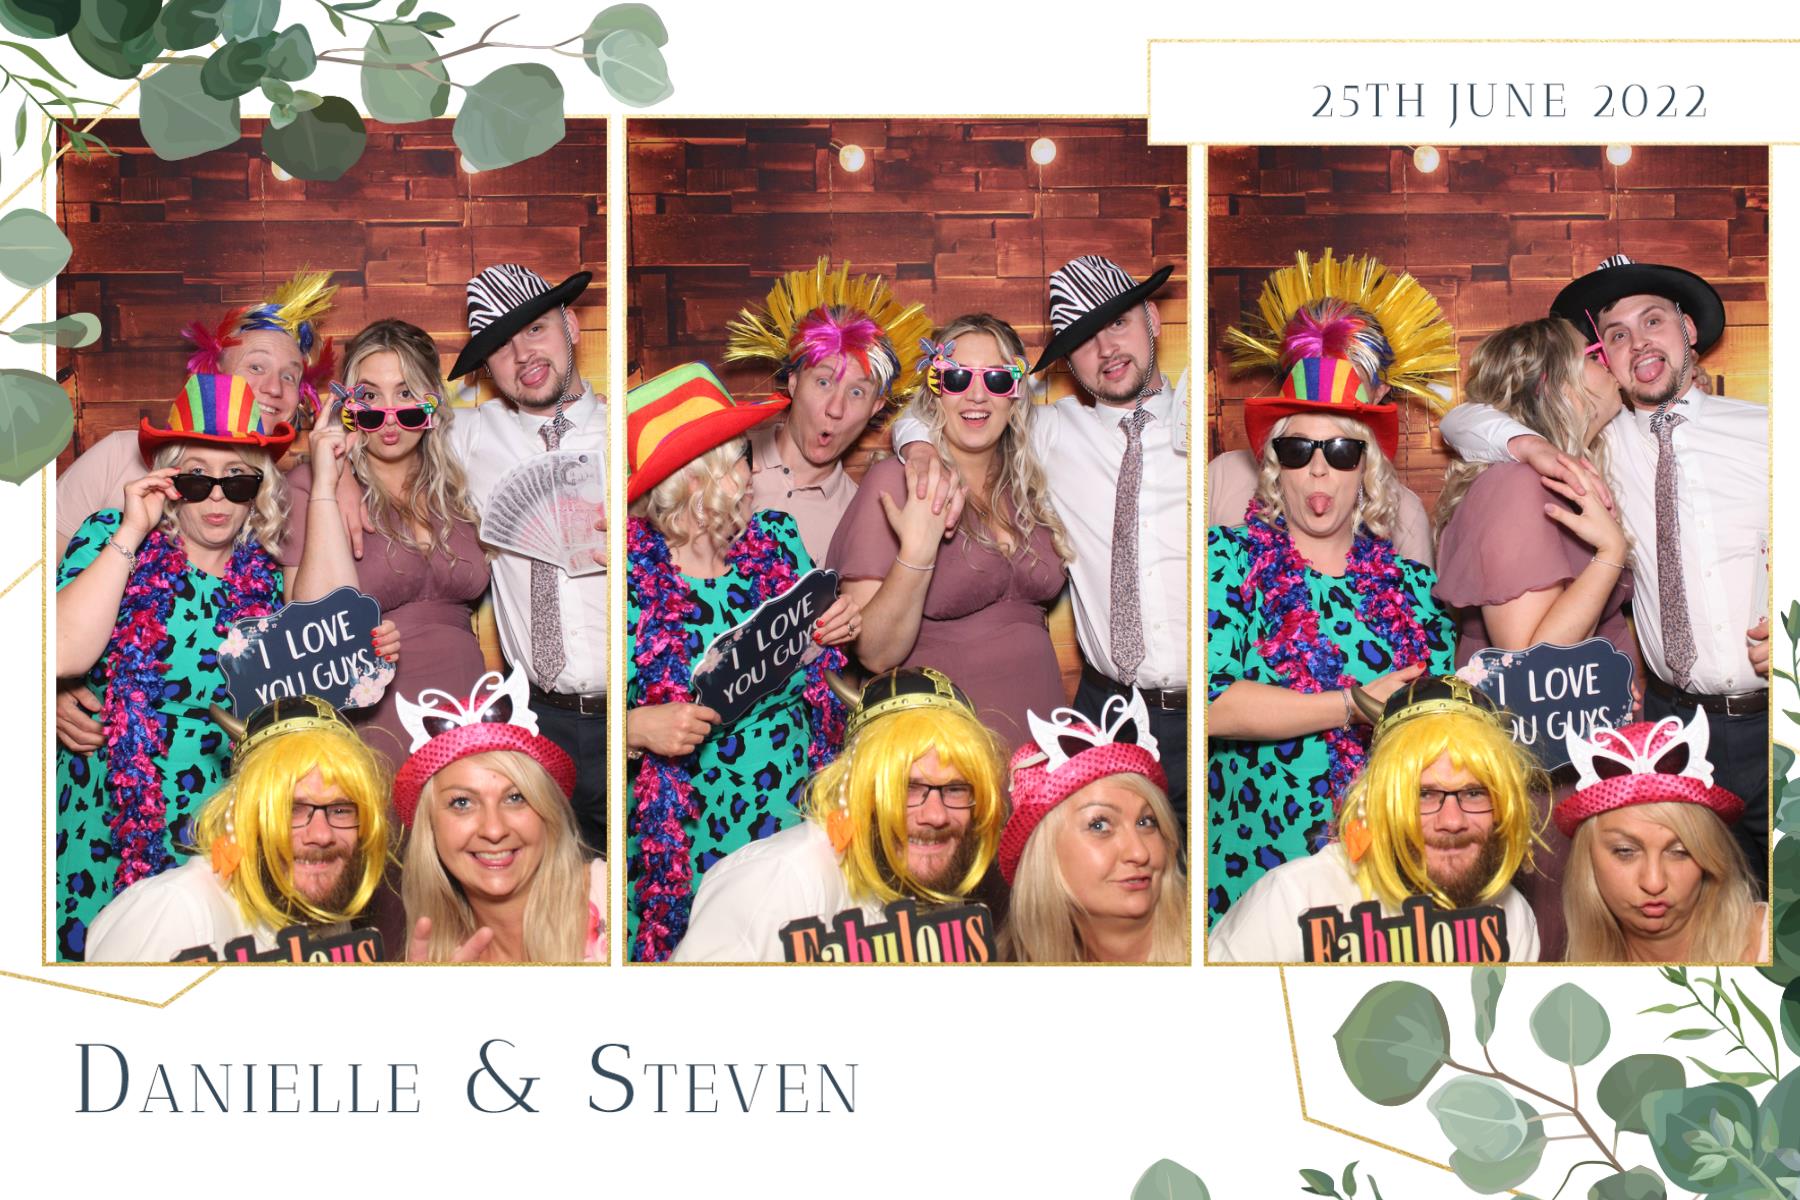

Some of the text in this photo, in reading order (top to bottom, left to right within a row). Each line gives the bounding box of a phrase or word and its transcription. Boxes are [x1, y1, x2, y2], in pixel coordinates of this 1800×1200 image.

[258, 610, 356, 670] I LOVE
[731, 592, 814, 670] I LOVE
[255, 648, 375, 705] YOU GUYS
[723, 618, 820, 704] YOU GUY
[1498, 663, 1601, 706] I LOVE
[1546, 706, 1613, 741] GUYS
[1308, 906, 1502, 963] Fabulous
